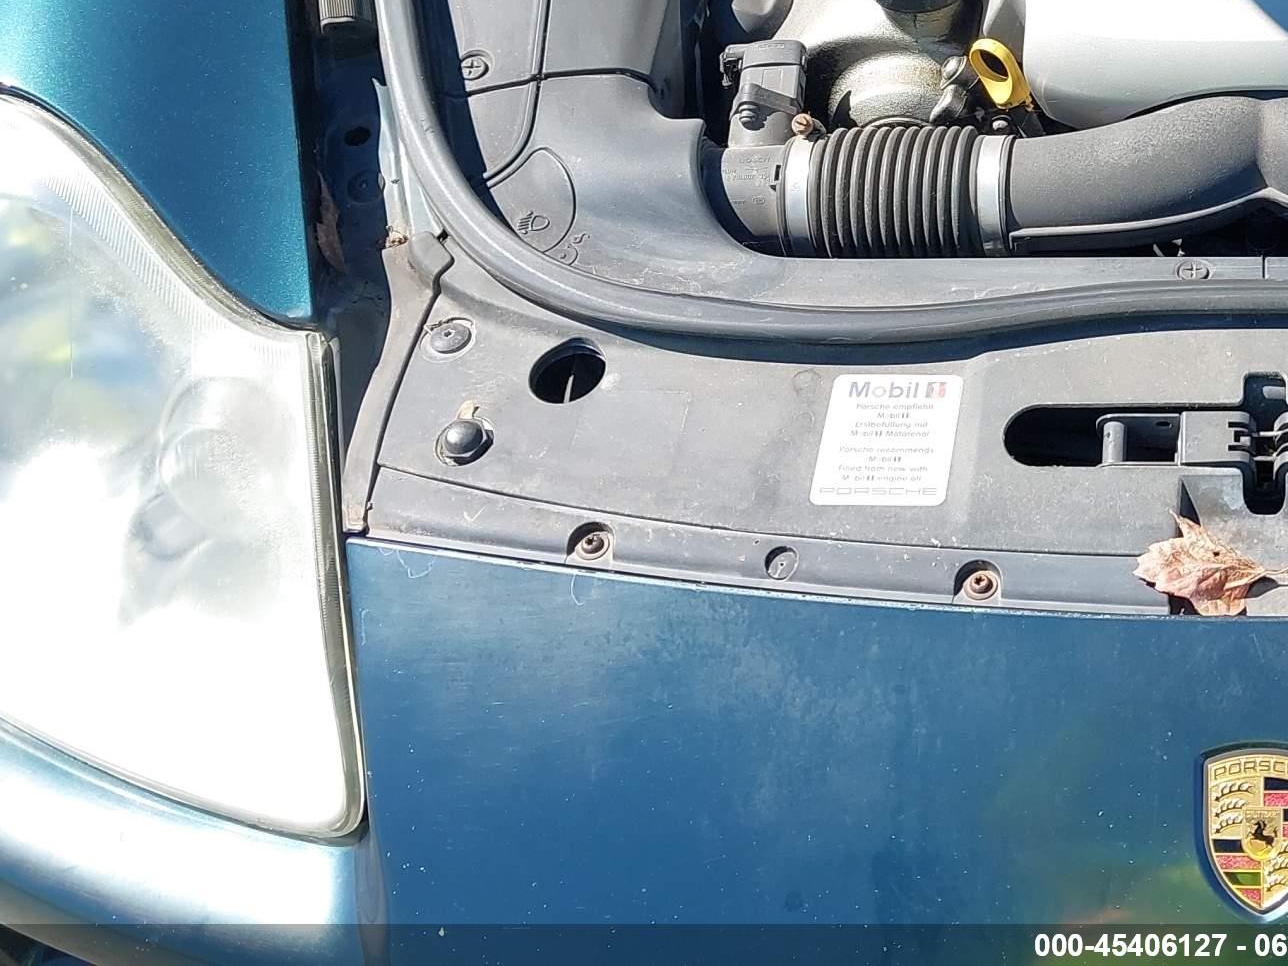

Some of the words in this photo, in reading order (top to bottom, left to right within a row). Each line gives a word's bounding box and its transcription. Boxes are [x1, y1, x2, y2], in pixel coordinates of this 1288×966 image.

[848, 381, 920, 398] Mobil
[841, 474, 865, 482] Mbil
[819, 487, 937, 496] PORSCHE
